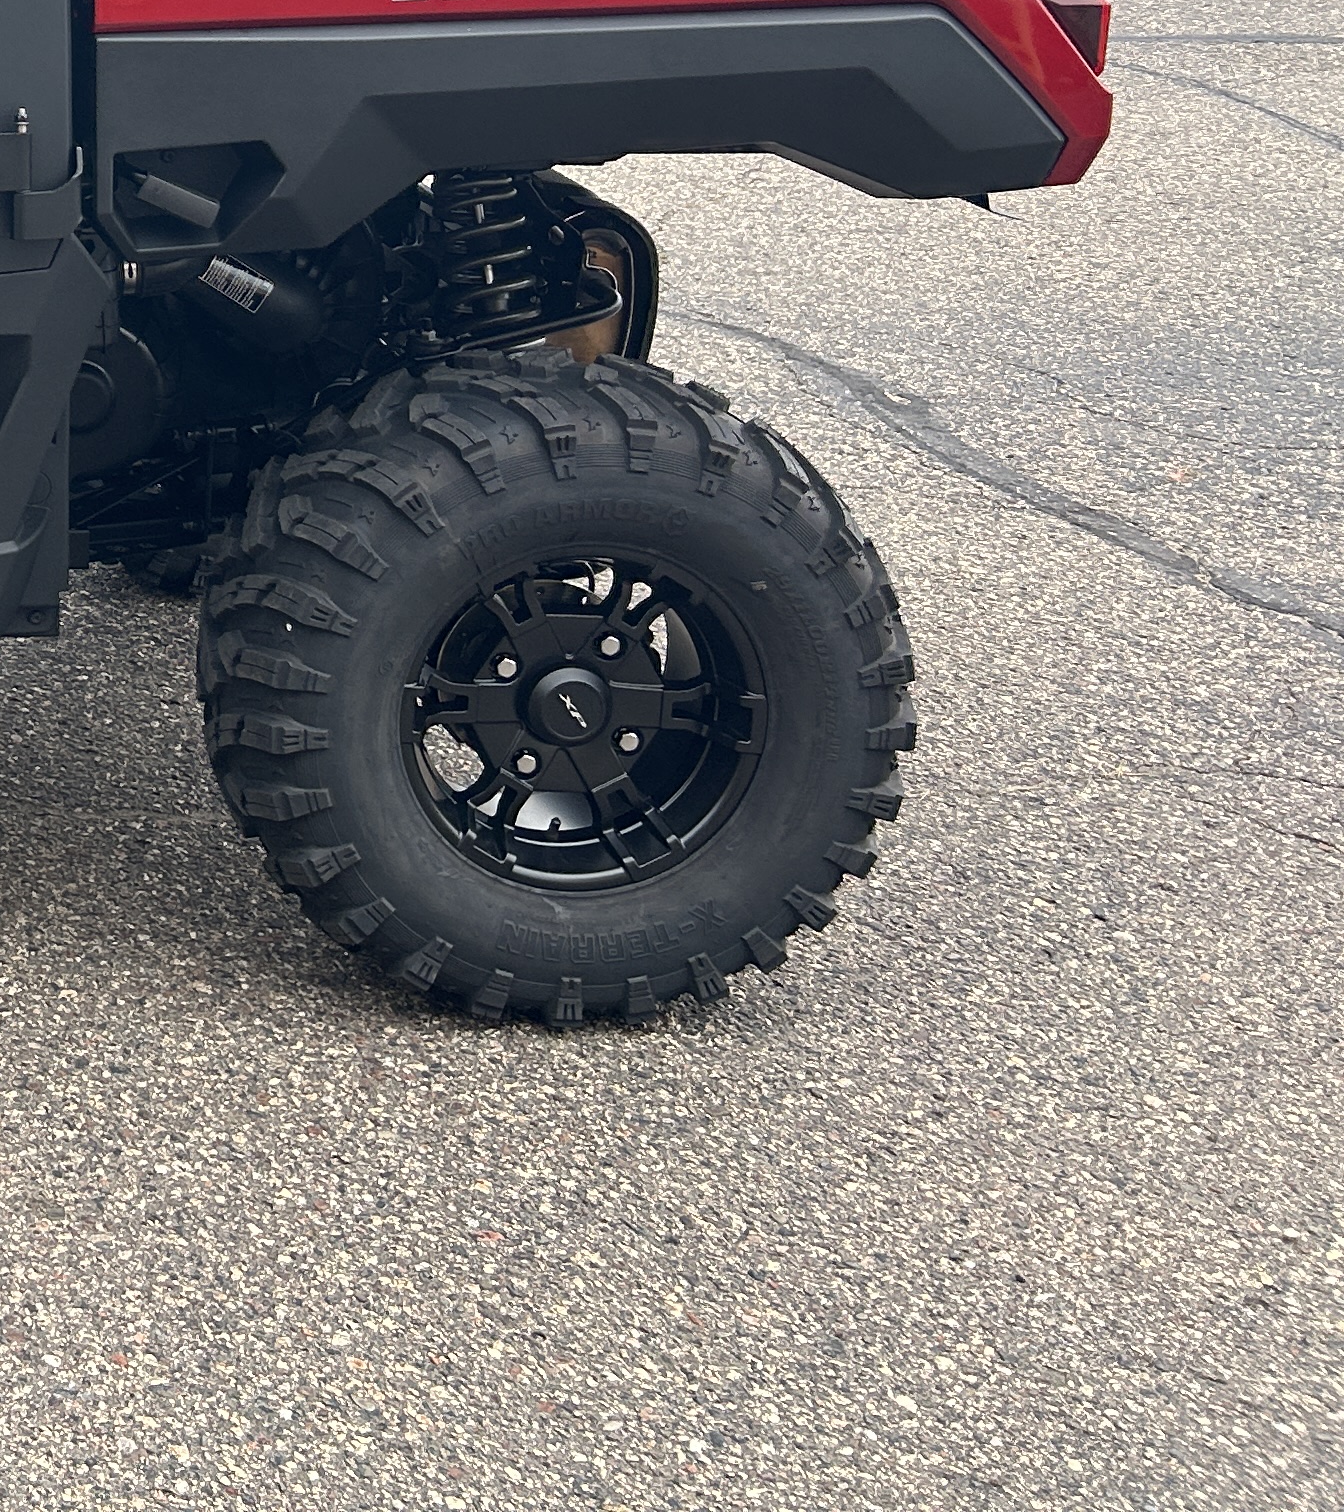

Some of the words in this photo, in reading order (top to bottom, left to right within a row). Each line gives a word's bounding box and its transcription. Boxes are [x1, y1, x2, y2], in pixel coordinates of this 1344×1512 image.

[532, 497, 660, 529] ARMOR
[558, 692, 587, 729] XP
[495, 897, 731, 963] X-TERRAIN
